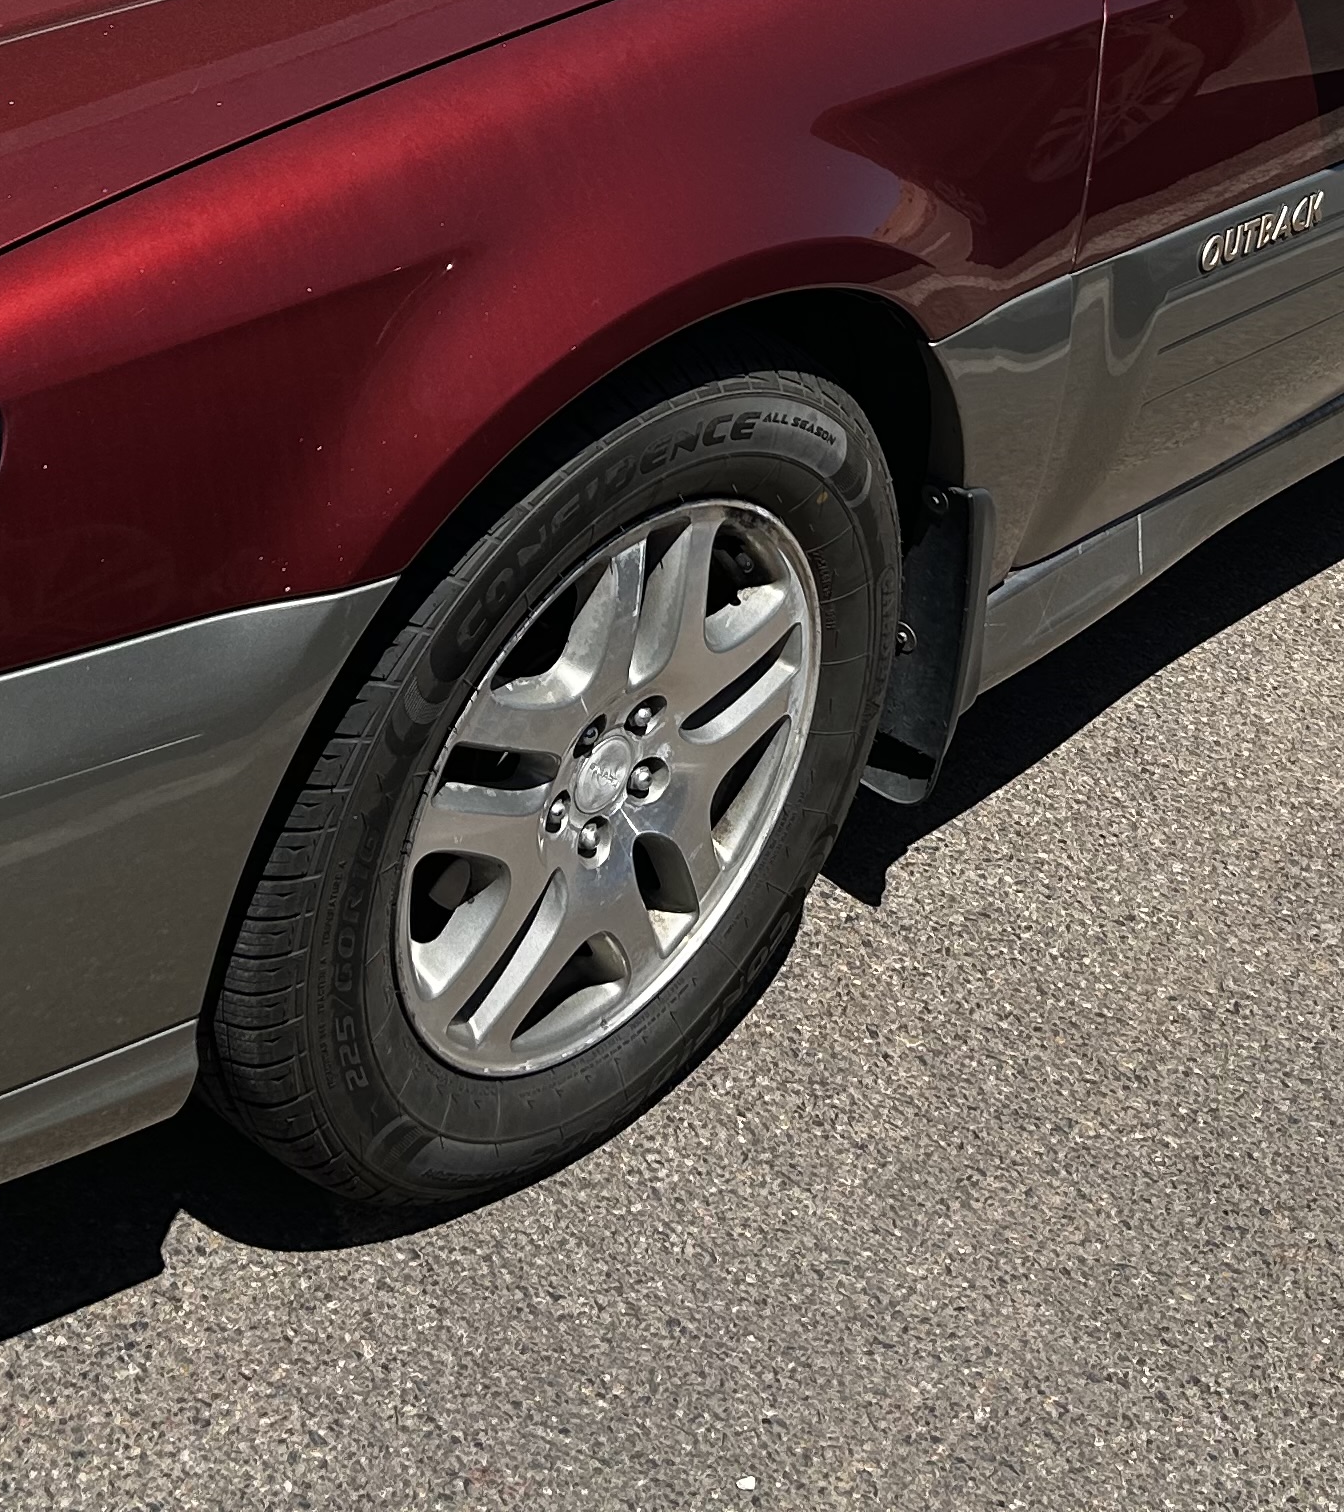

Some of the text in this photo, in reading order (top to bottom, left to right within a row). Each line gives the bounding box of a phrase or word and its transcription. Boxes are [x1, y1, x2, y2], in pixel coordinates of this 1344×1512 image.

[1200, 190, 1325, 272] OUTBACK
[456, 411, 837, 654] CONFIDENCE ALL SEASON
